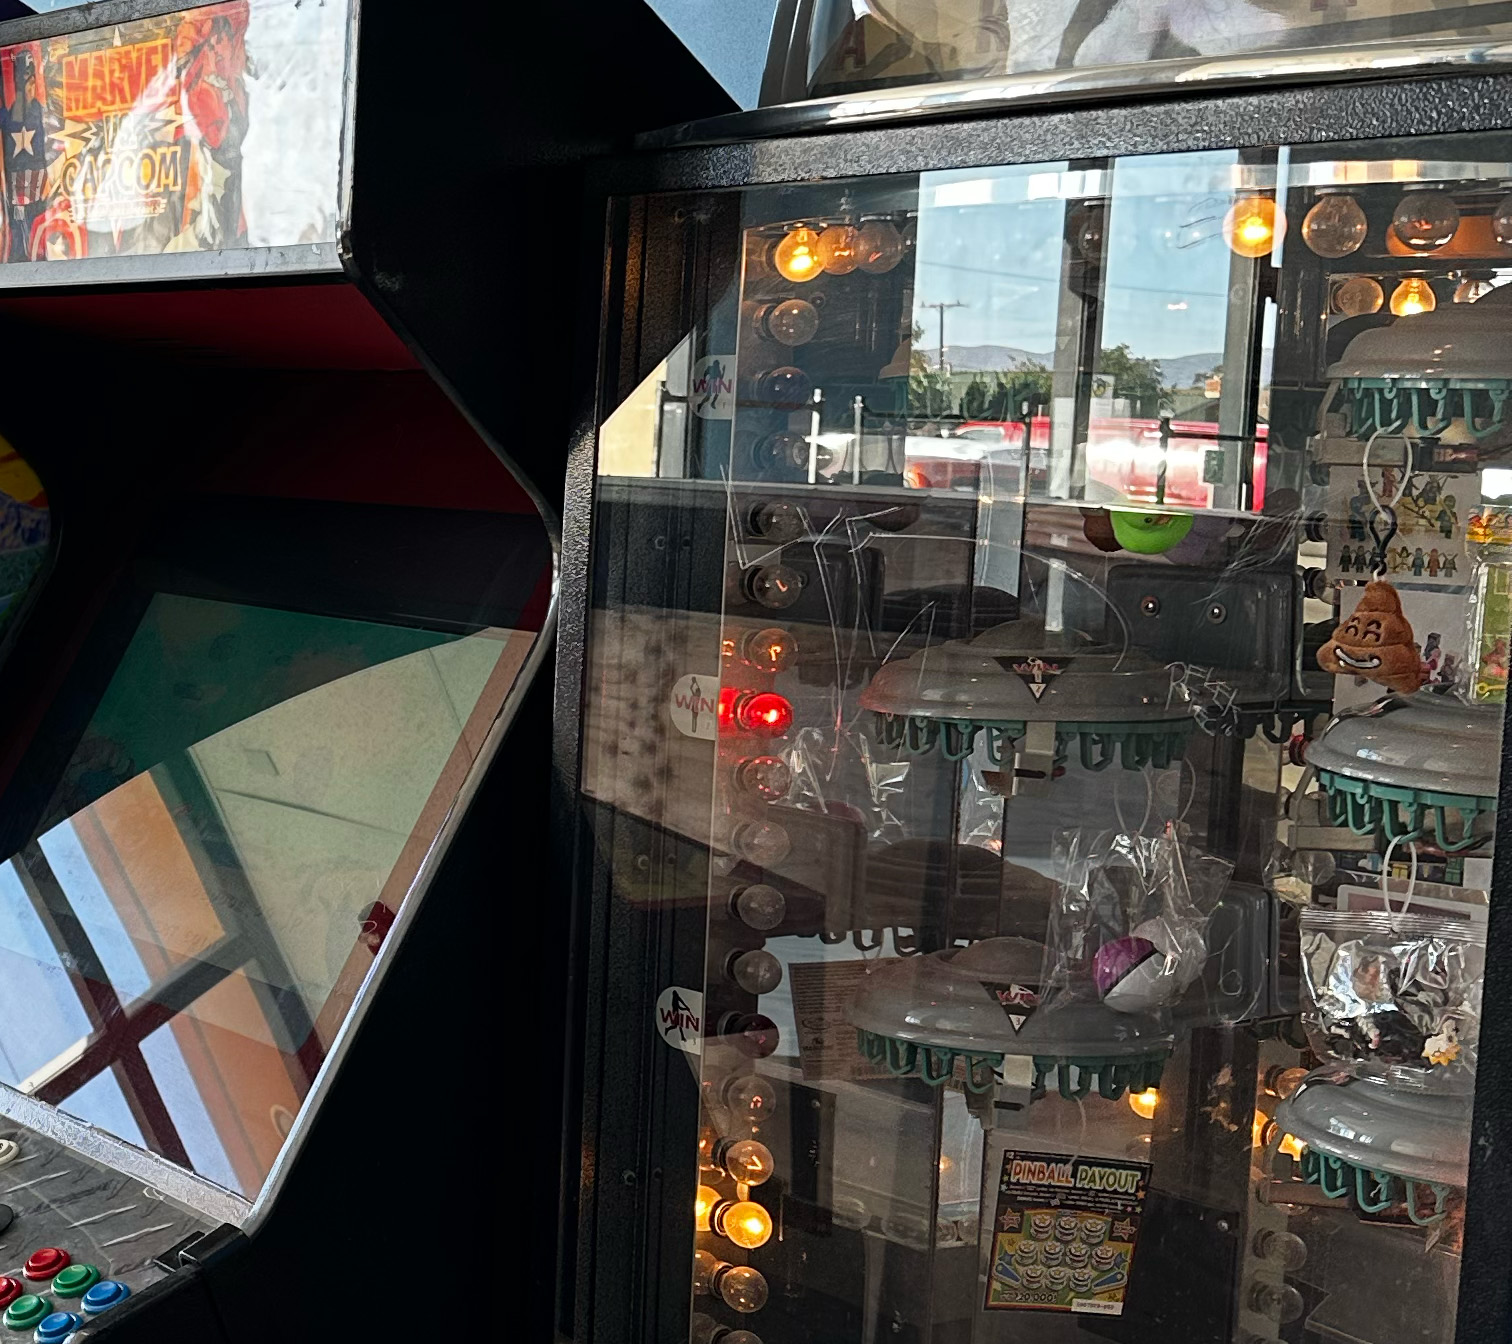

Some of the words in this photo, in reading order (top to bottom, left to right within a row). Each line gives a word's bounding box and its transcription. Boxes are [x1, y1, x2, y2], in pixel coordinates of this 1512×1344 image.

[63, 37, 180, 119] MARVEL
[61, 146, 182, 199] CAPCOM
[693, 379, 732, 394] WIN
[675, 693, 715, 714] WIN
[660, 1007, 699, 1032] WIN
[1010, 1159, 1075, 1187] PINBALL
[1076, 1165, 1141, 1194] PAYOUT
